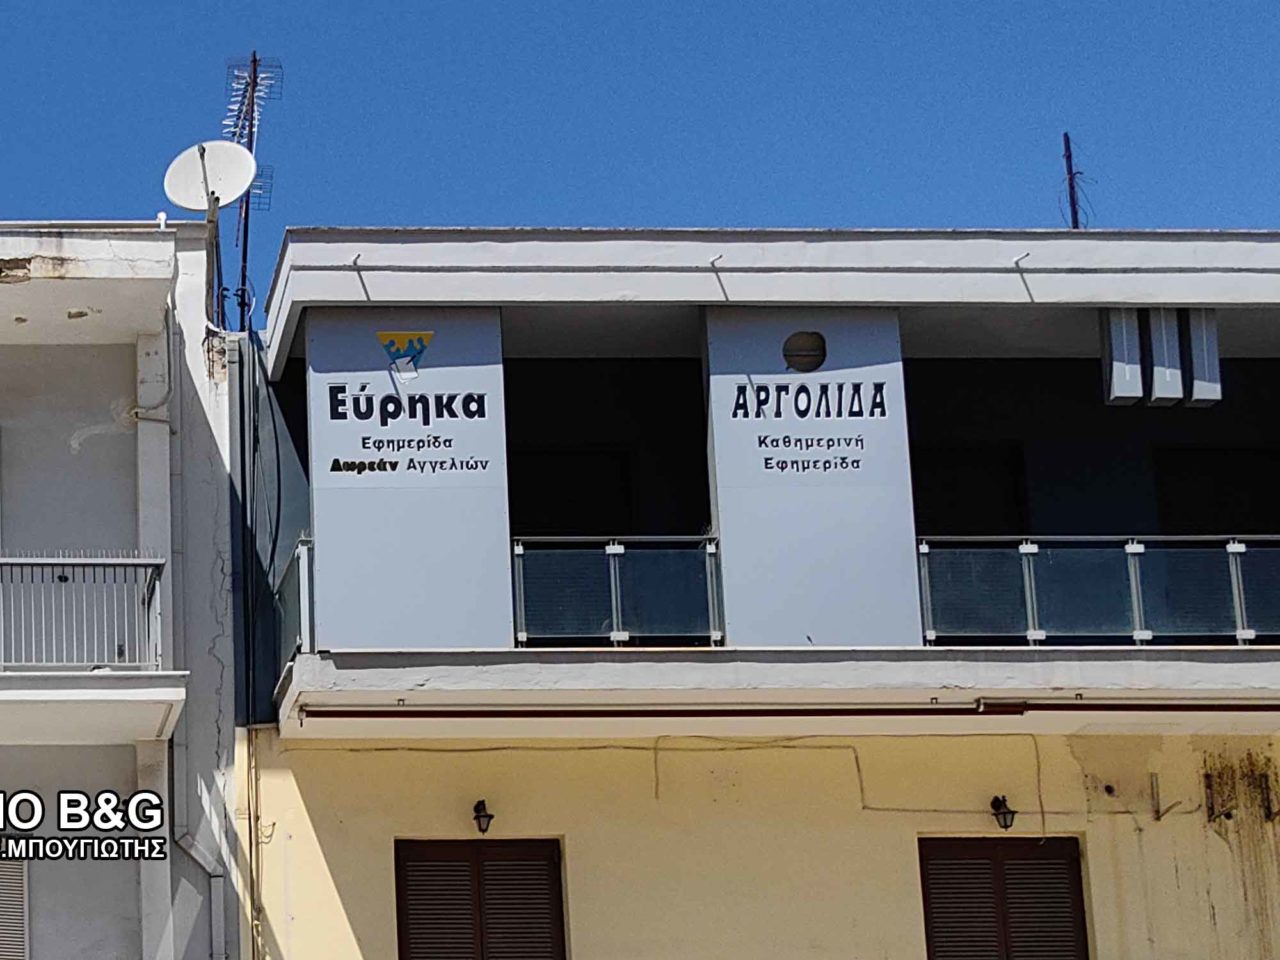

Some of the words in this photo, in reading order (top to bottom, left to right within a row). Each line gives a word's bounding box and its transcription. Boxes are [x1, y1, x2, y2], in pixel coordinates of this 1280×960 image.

[328, 384, 487, 427] Εύρηκα
[731, 382, 887, 418] ΑΡΓΟΛΙΔΑ
[361, 434, 453, 451] Εφημερίδα
[758, 434, 865, 450] Καθημερινή
[330, 458, 399, 474] Δωρεάν
[406, 456, 489, 473] Αγγελιών
[763, 456, 861, 472] Εφημερίδα
